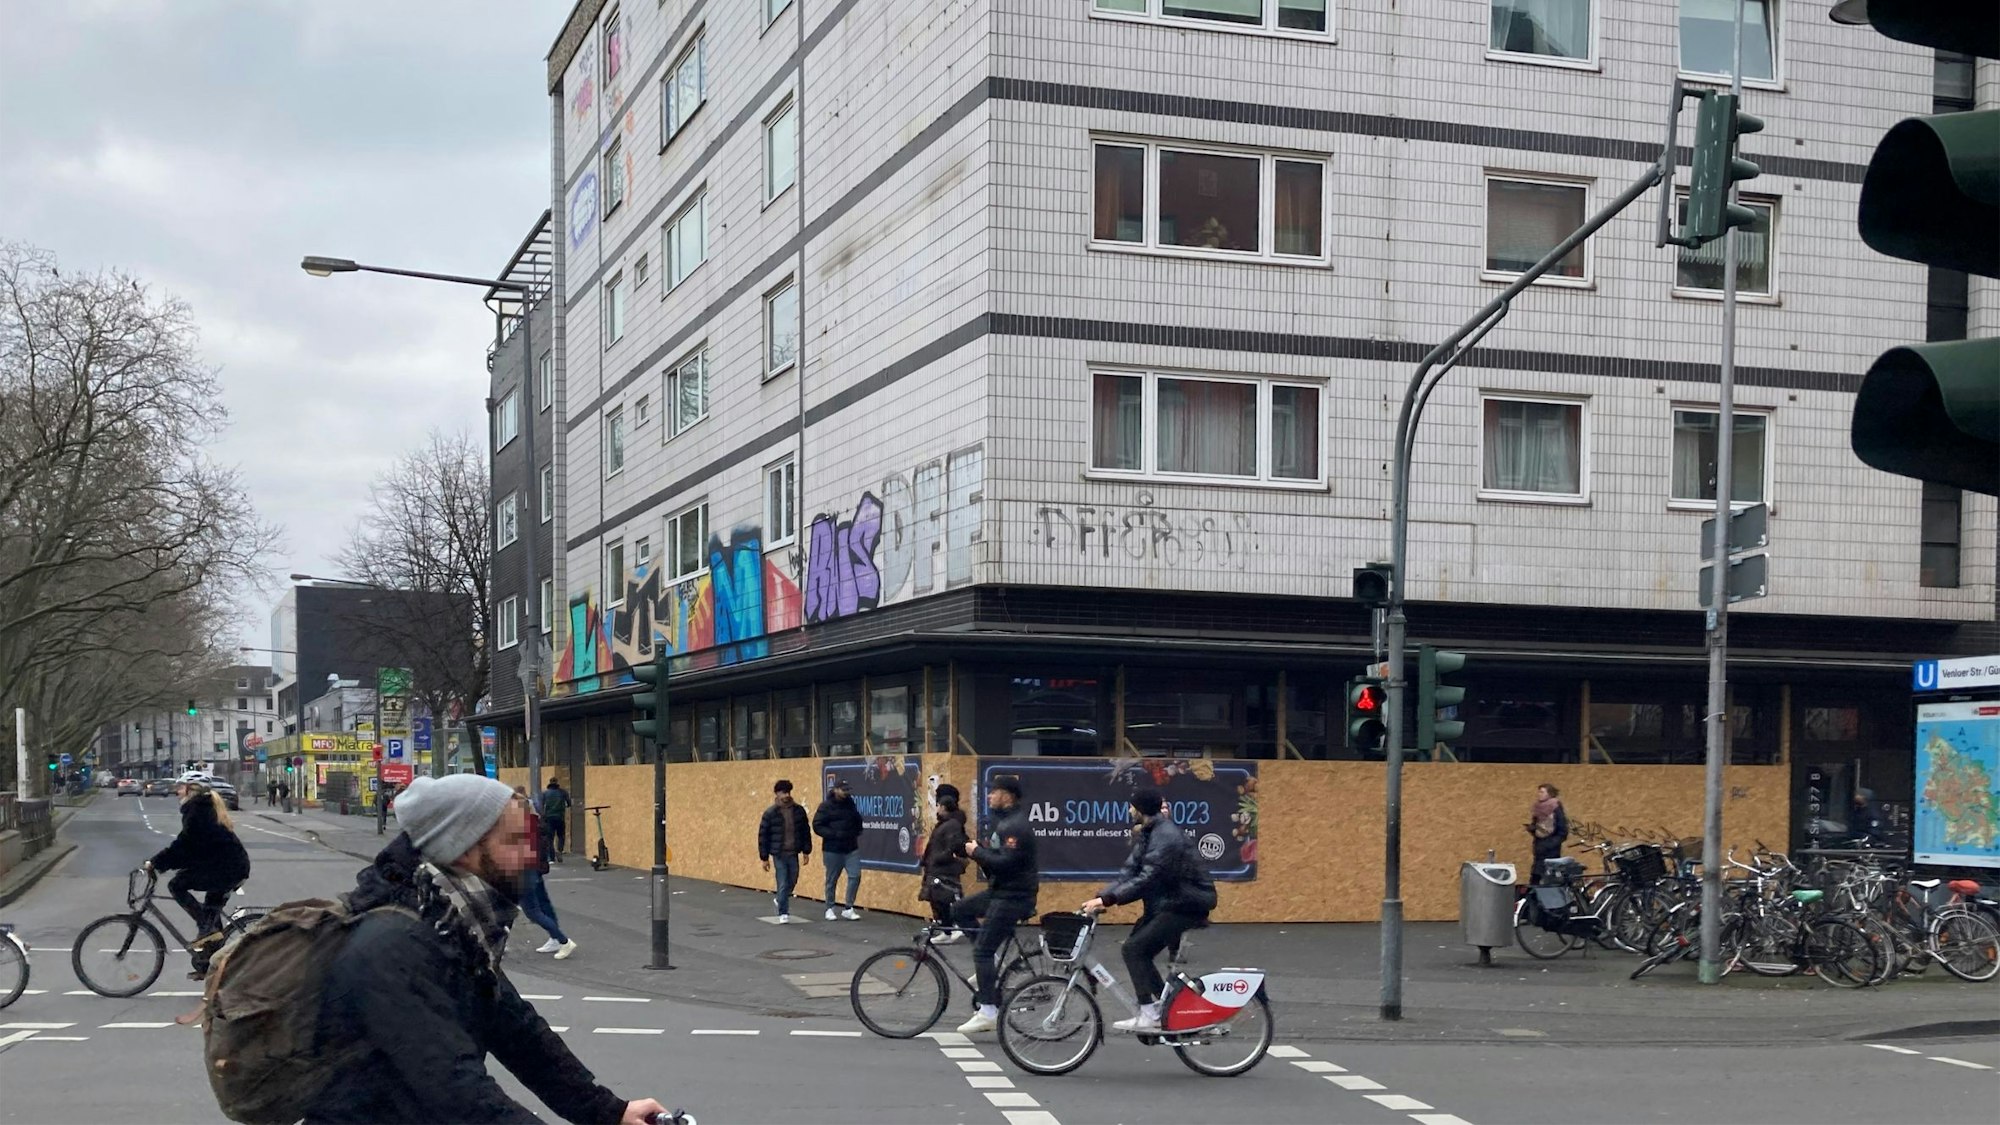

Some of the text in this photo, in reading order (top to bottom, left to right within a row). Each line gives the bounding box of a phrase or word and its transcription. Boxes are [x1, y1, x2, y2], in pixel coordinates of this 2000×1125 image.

[1918, 664, 1933, 687] U
[390, 741, 401, 755] P
[851, 795, 904, 817] OMMER 2023
[1028, 803, 1059, 822] Ab
[1065, 800, 1129, 824] SOMM
[1048, 829, 1062, 837] wir
[1064, 828, 1081, 837] hier
[1083, 829, 1094, 837] an
[1096, 828, 1122, 837] dieser
[1213, 983, 1233, 992] KVB
